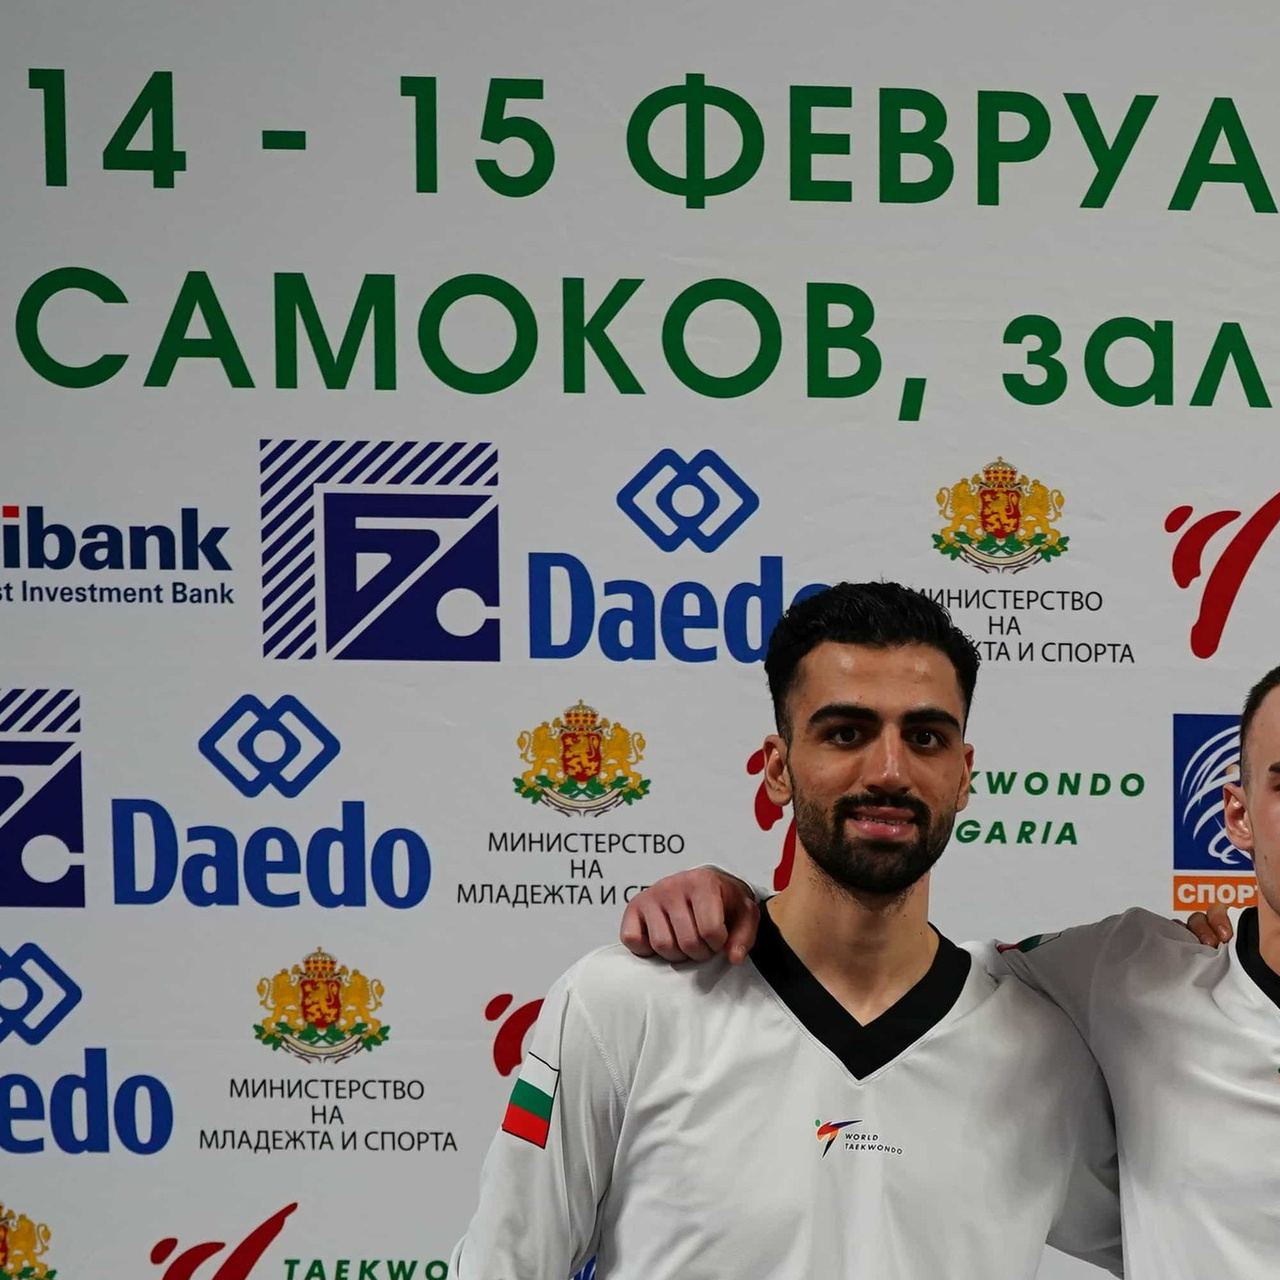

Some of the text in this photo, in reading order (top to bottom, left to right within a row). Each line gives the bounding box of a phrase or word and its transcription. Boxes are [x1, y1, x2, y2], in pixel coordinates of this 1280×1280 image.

[28, 68, 186, 188] 14
[262, 130, 306, 150] -
[400, 76, 555, 197] 15
[15, 267, 926, 421] САМОКОВ,
[2, 506, 232, 570] ibank
[22, 581, 163, 603] Investment
[172, 582, 234, 603] Bank
[529, 555, 831, 663] Daed
[989, 616, 1021, 635] НА
[1019, 642, 1033, 661] И
[1042, 643, 1134, 663] СПОРТА
[968, 770, 1147, 798] KWONDO
[489, 832, 684, 854] МИНИСТЕРСТВО
[955, 820, 1080, 847] GARIA
[112, 799, 431, 909] Daedo
[571, 859, 603, 878] НА
[458, 884, 592, 908] МЛАДЕЖТА
[601, 886, 615, 904] И
[1177, 882, 1256, 907] СПОР
[0, 1048, 173, 1155] edo
[230, 1079, 424, 1100] МИНИСТЕРСТВО
[312, 1105, 344, 1124] НА
[200, 1130, 457, 1153] МЛАДЕЖТА И СПОРТА
[846, 1143, 902, 1154] TAEKWONDO
